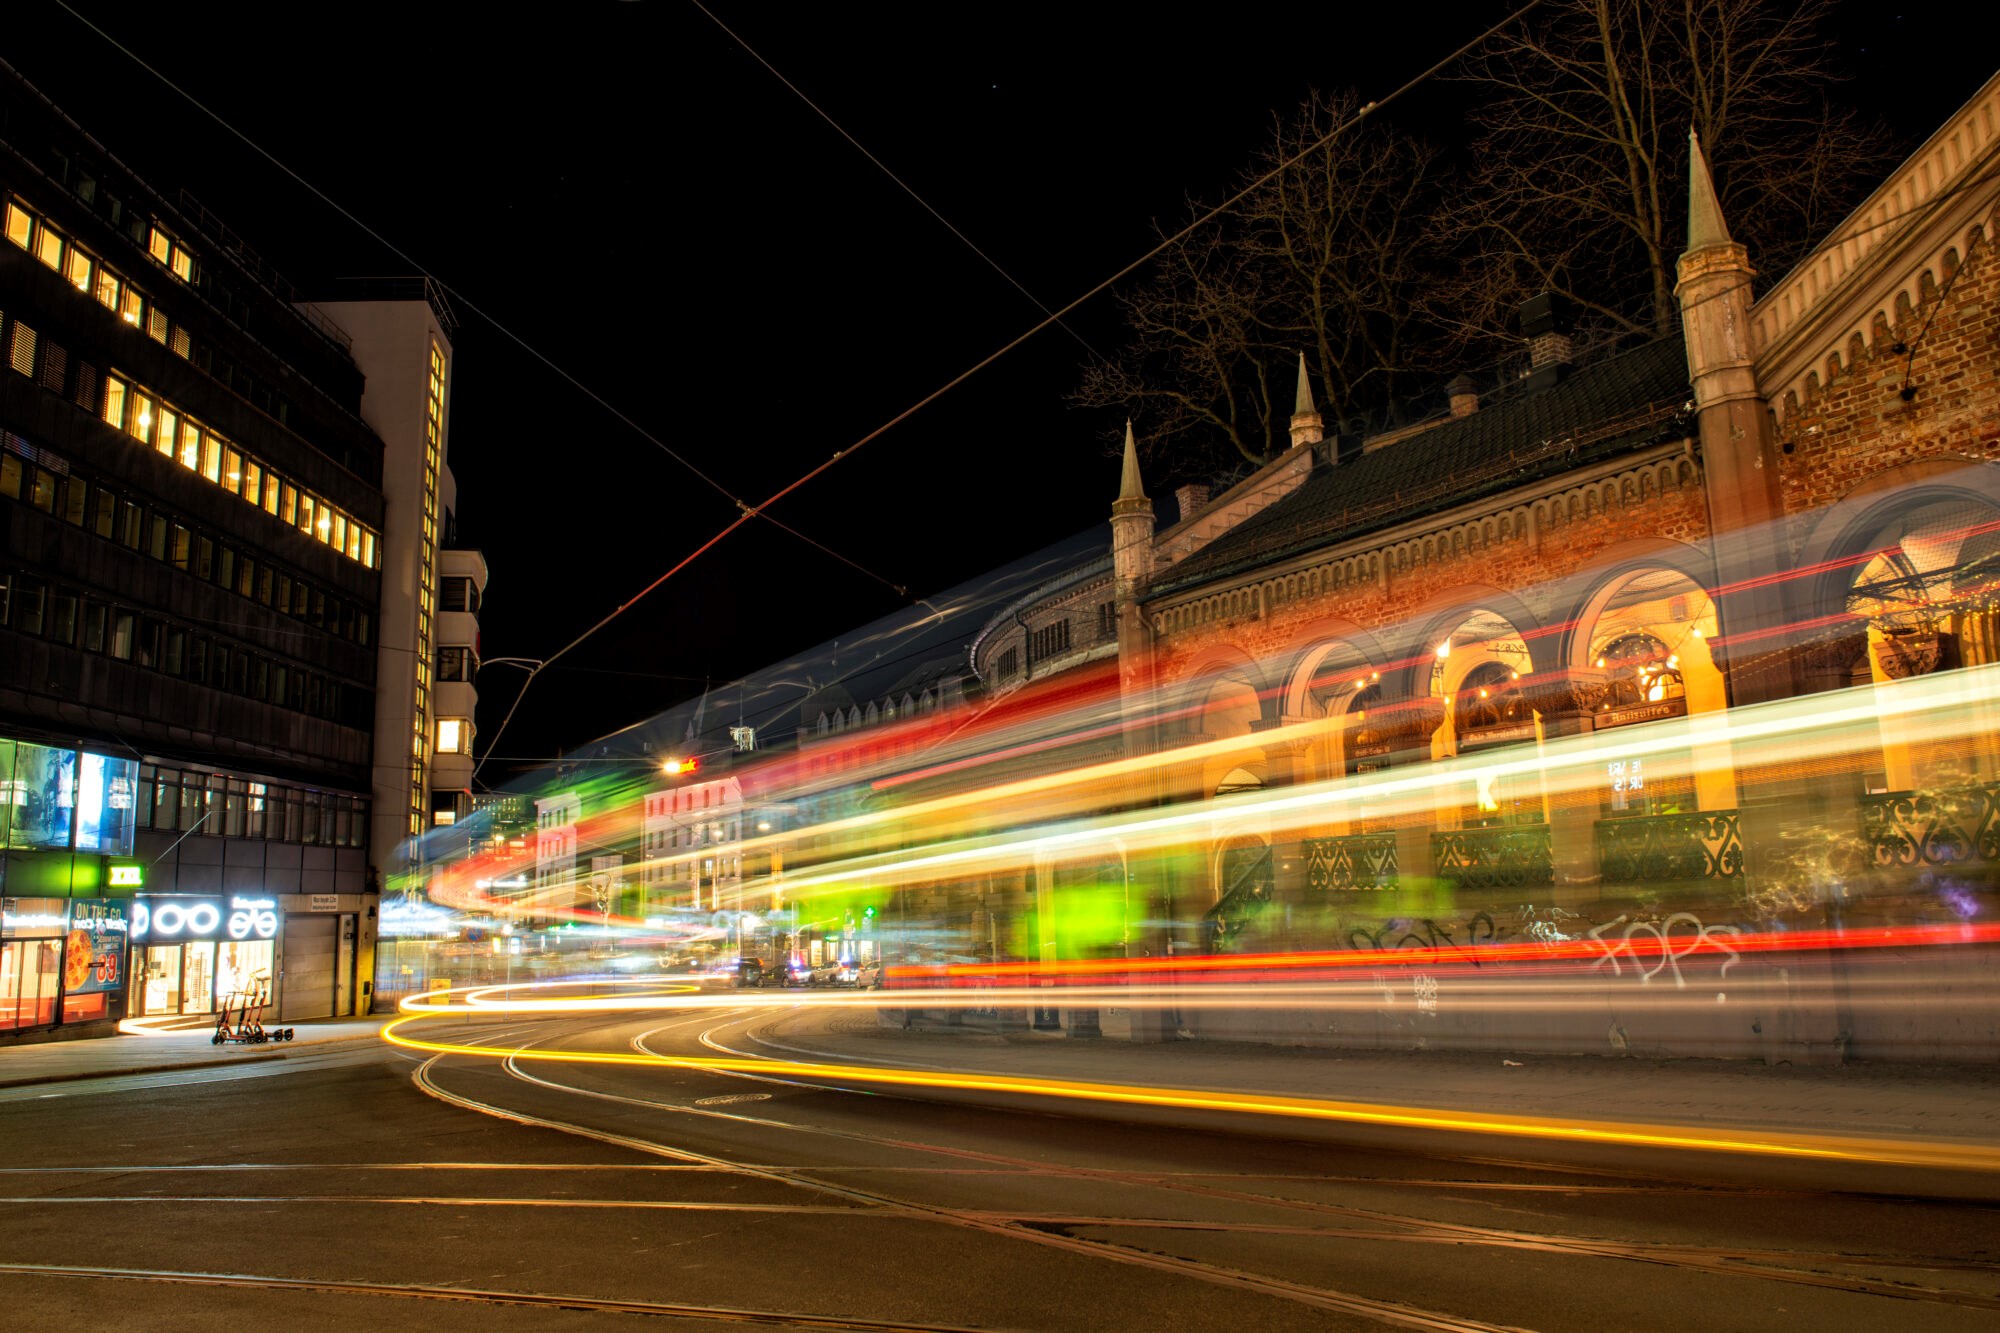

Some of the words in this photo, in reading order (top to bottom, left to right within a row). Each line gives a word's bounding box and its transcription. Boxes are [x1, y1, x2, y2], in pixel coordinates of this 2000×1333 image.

[109, 866, 143, 885] XXL
[76, 903, 89, 919] ON
[91, 905, 108, 920] THE
